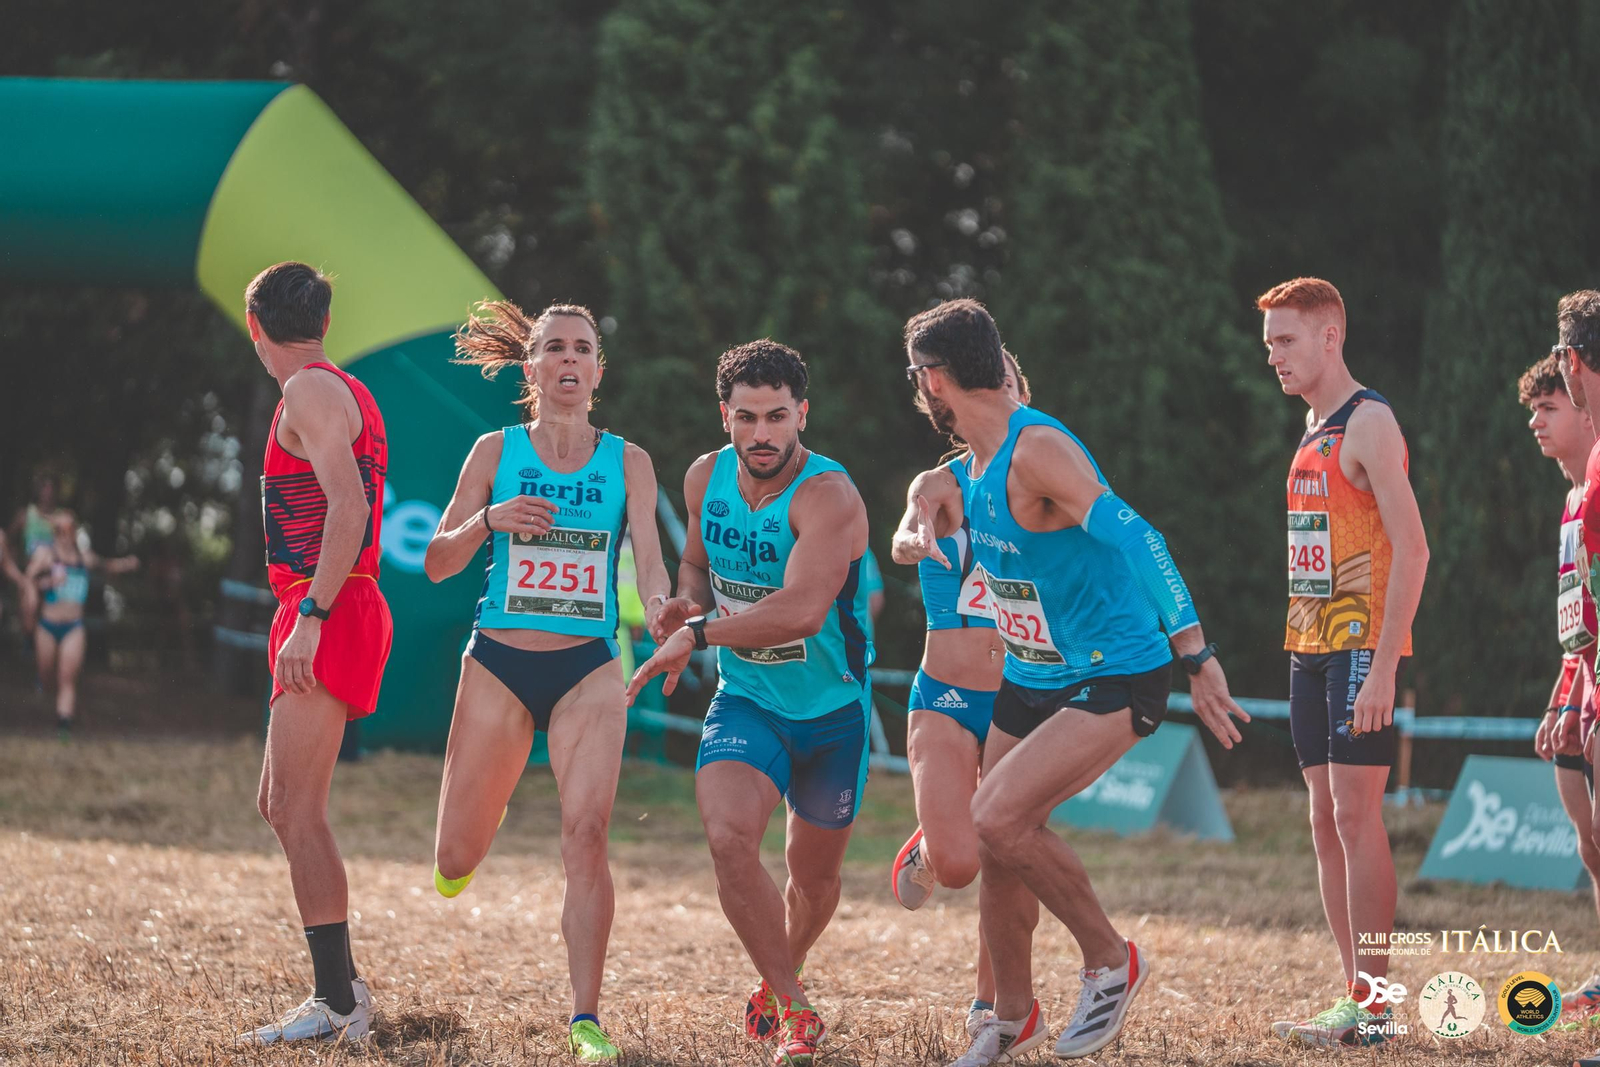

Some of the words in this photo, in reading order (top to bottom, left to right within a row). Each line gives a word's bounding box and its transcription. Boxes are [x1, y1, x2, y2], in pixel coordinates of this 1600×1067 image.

[518, 481, 604, 506] nerja
[539, 530, 585, 544] ITÁLICA
[1143, 530, 1189, 612] TROTASIERRA
[1289, 544, 1326, 573] 248
[517, 560, 599, 595] 2251
[726, 584, 769, 599] ITÁLICA
[992, 602, 1048, 644] 2252
[1560, 600, 1581, 634] 2239
[1348, 649, 1358, 682] Deporti
[1357, 650, 1371, 683] ZUB
[933, 699, 969, 709] adidas
[704, 736, 748, 748] nerja
